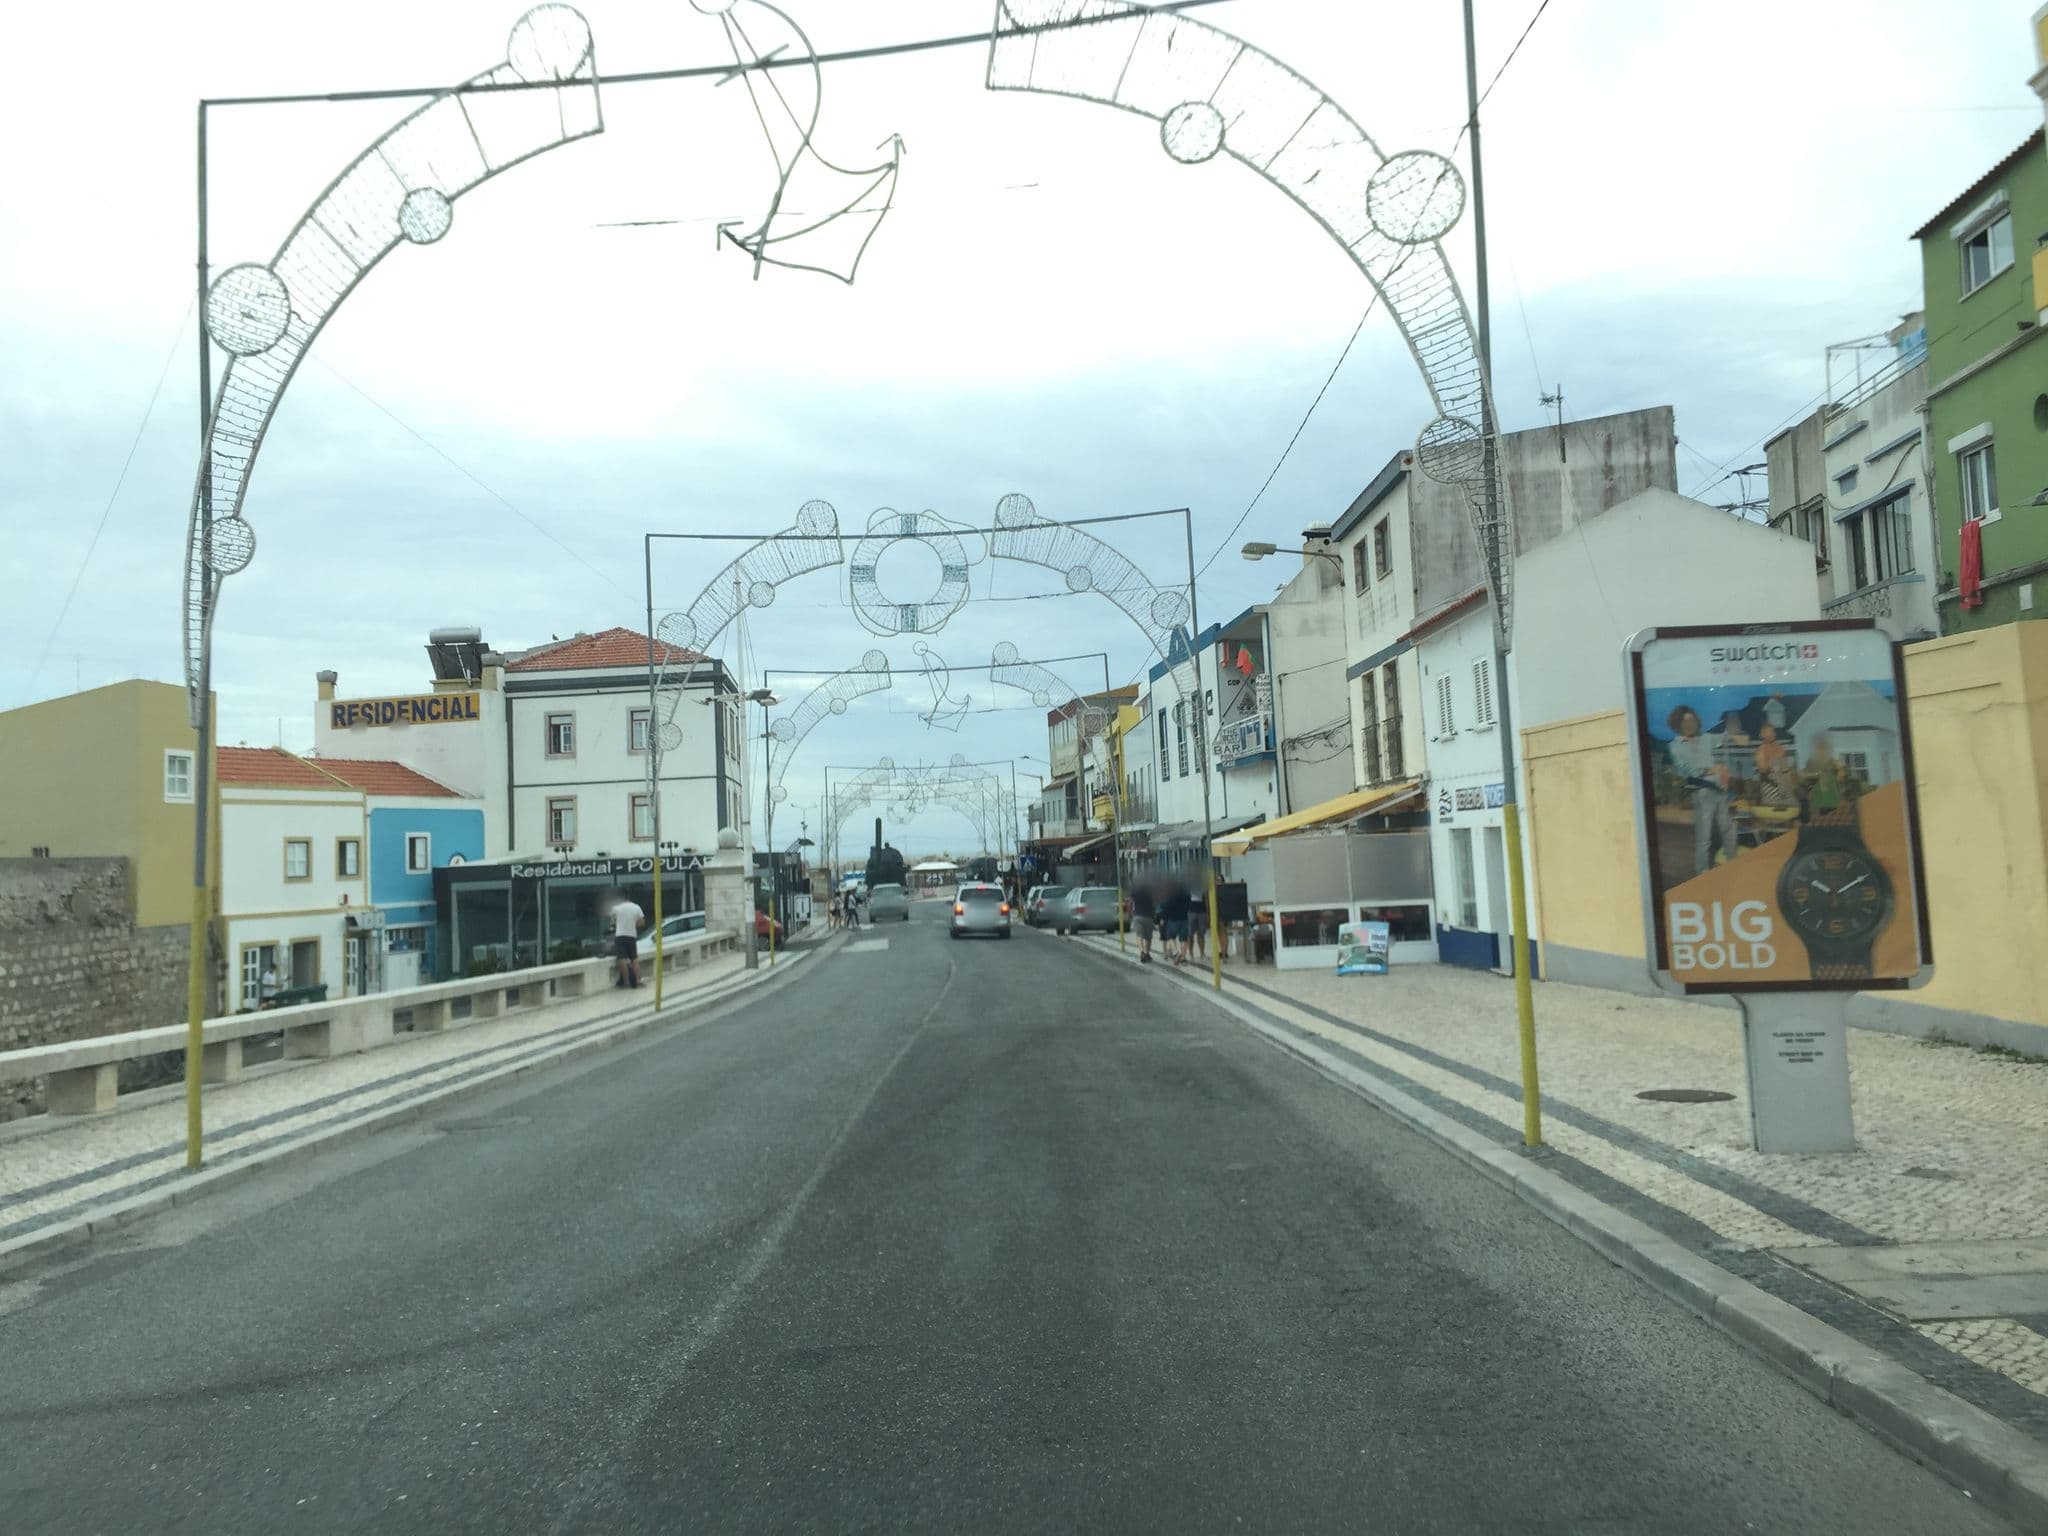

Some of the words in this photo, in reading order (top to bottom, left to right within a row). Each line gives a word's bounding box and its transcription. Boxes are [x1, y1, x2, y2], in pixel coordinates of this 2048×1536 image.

[1711, 642, 1800, 662] swatch
[333, 696, 477, 727] RESIDENCIAL
[1214, 745, 1240, 755] BAR
[1668, 900, 1773, 943] BIG
[1672, 943, 1777, 970] BOLD
